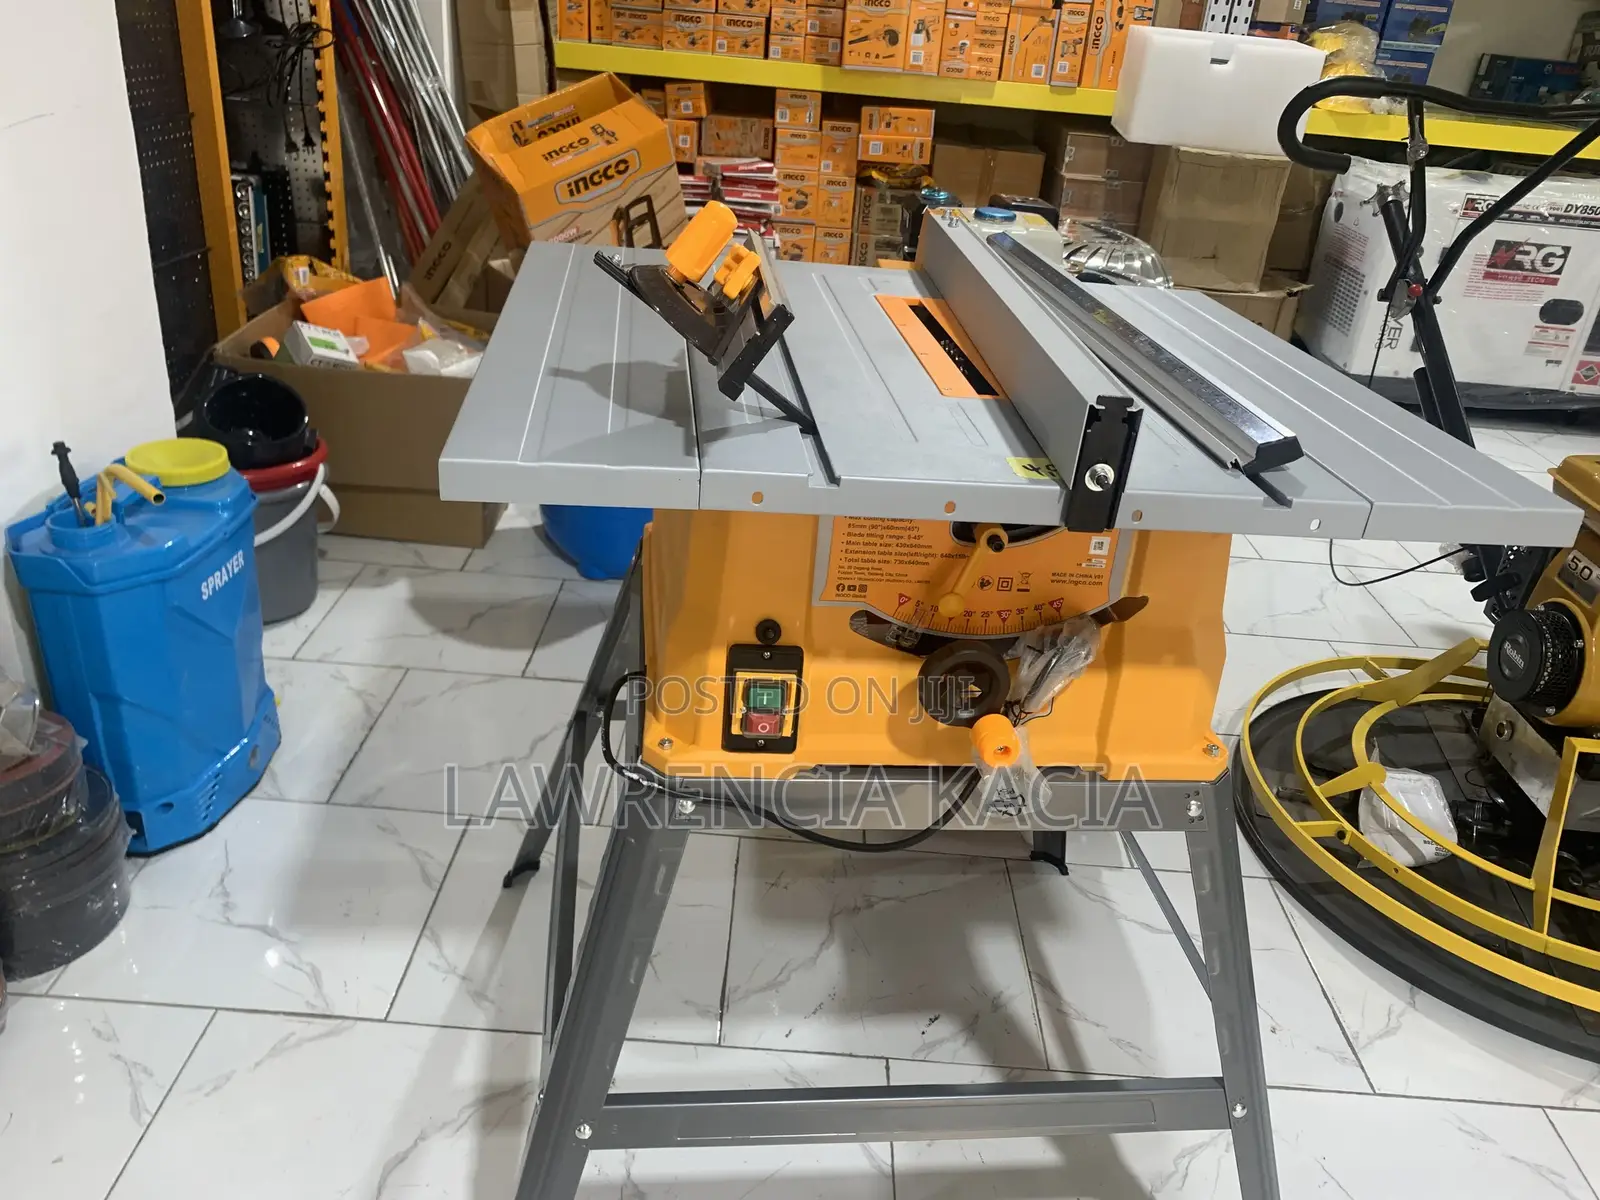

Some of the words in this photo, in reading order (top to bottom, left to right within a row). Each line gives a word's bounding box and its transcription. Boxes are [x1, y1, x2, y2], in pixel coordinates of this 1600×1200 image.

[567, 158, 630, 198] INGCO
[201, 549, 244, 600] SPRAYER
[1504, 641, 1525, 670] Robin
